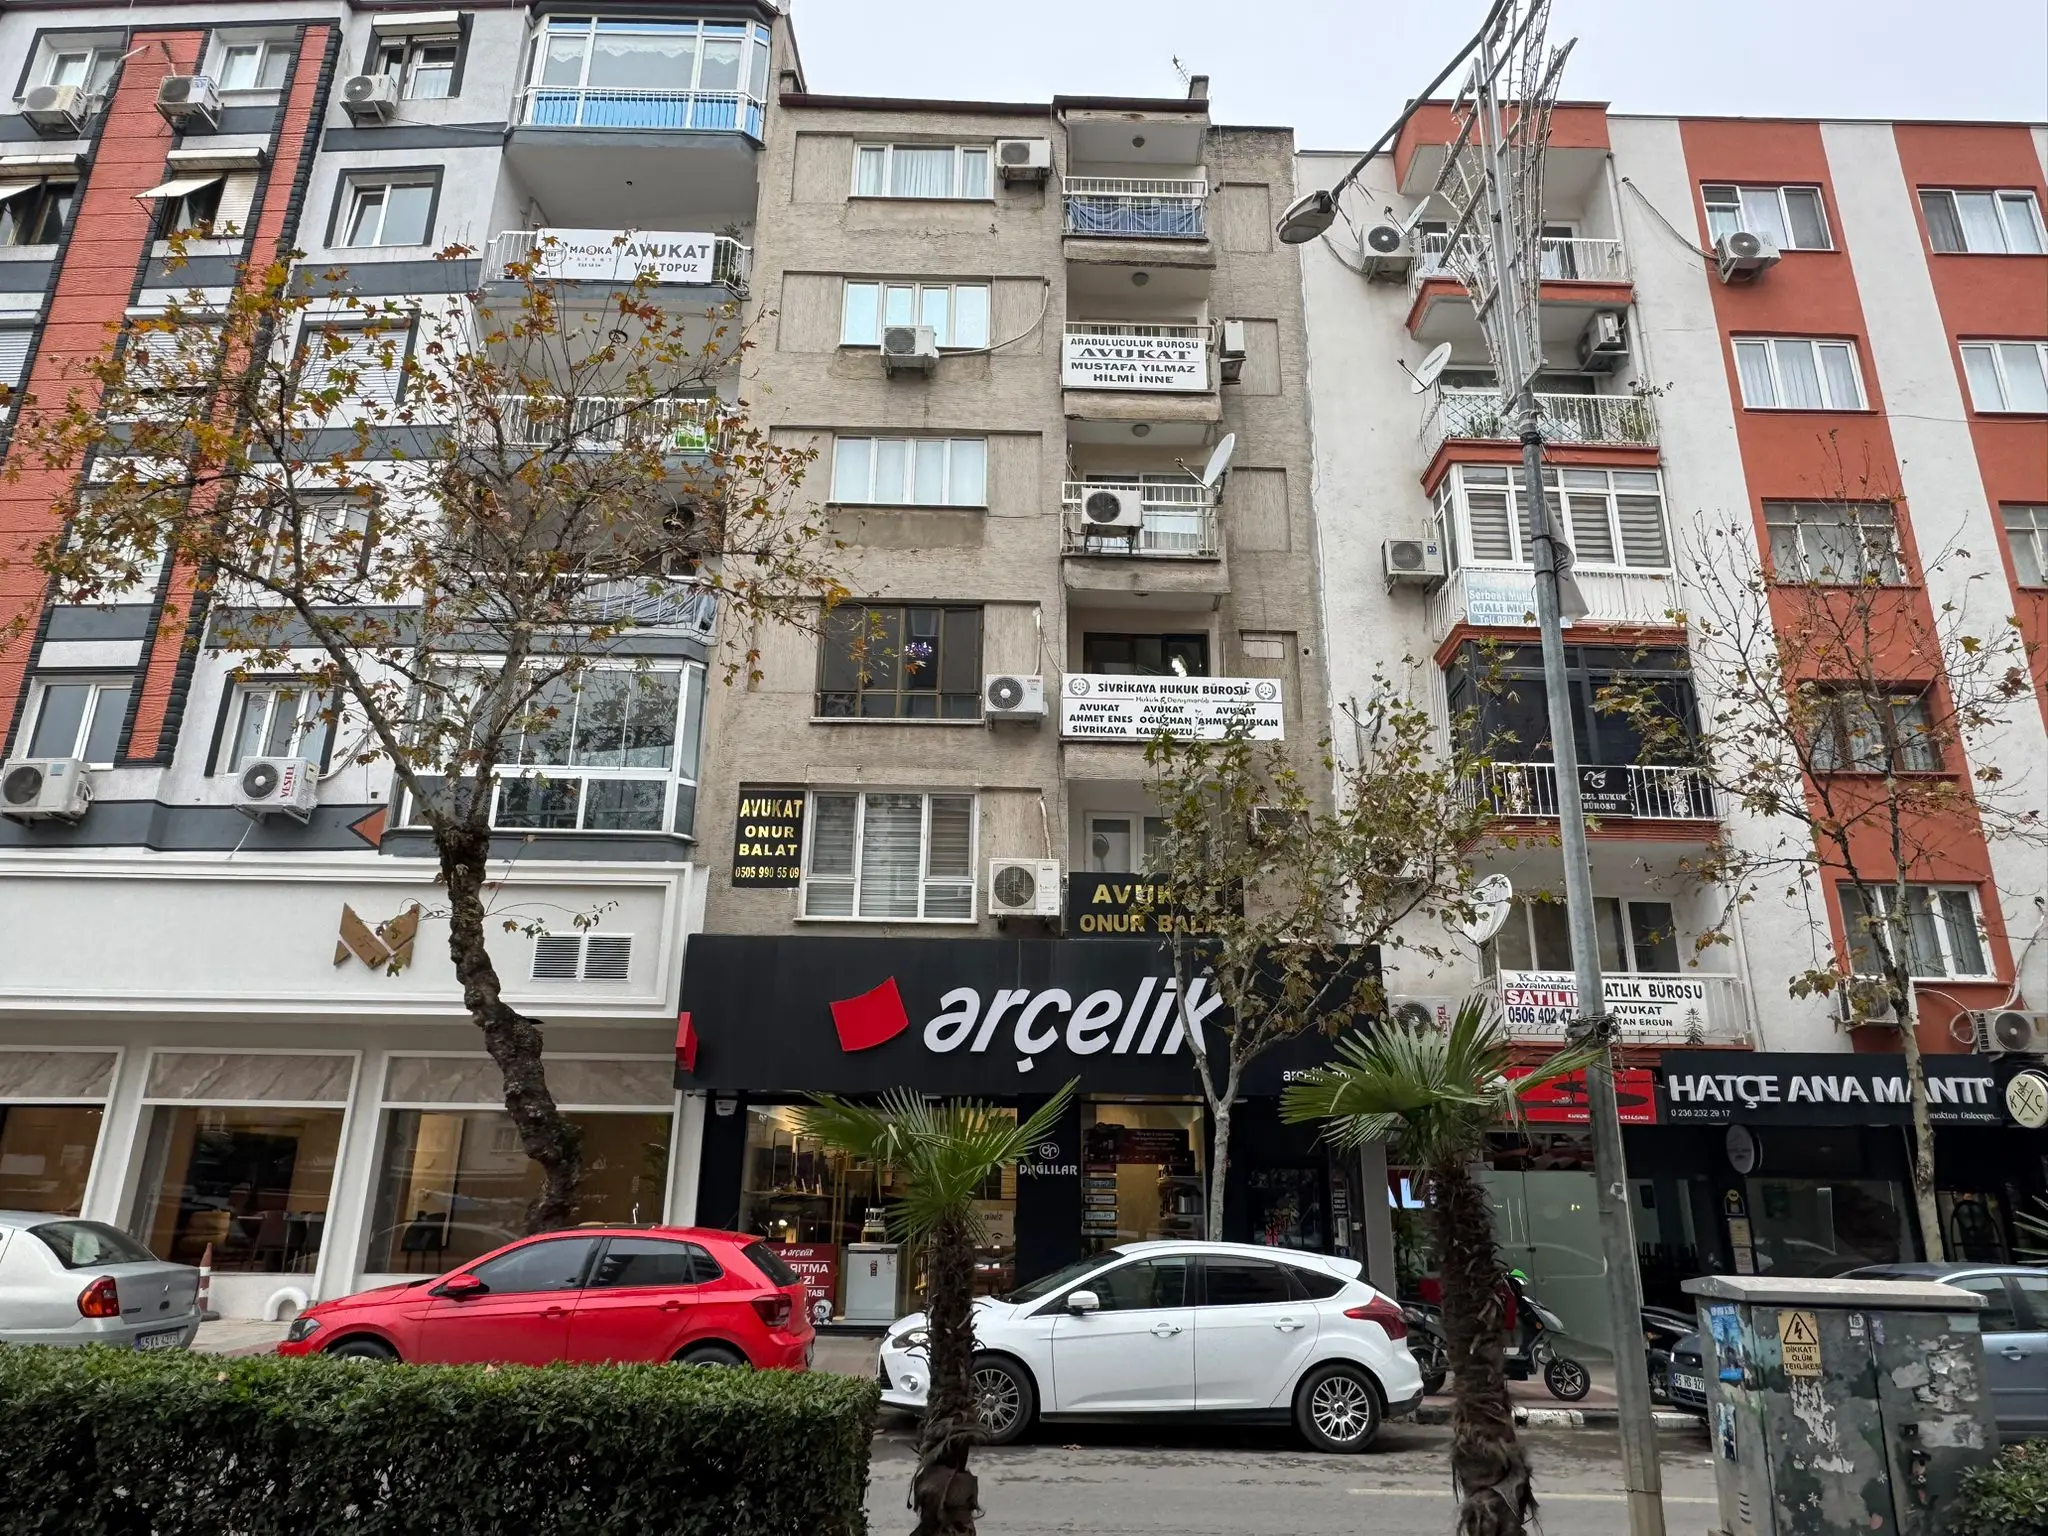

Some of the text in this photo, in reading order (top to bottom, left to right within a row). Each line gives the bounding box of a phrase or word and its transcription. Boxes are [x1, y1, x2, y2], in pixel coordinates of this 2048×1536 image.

[624, 243, 710, 259] AVUKAT
[659, 263, 698, 273] TOPUZ
[1070, 337, 1199, 349] ARABULUCULUK BÜROSU
[1079, 348, 1192, 360] AVUKAT
[1071, 362, 1196, 373] MUSTAFA YILMAZ
[1139, 374, 1174, 384] İNNE
[1097, 680, 1249, 696] SİVRİKAYA HUKUK BÜROSU
[1079, 703, 1120, 712] AVUKAT
[1143, 705, 1184, 714] AVUKAT
[1215, 707, 1256, 715] AVUKAT
[1069, 714, 1133, 723] AHMET ENES
[1139, 714, 1192, 726] OĞUZHAN
[1236, 718, 1278, 727] URKAN
[1072, 724, 1127, 734] SİVRİKAYA
[1598, 793, 1628, 801] HUKUK
[740, 799, 802, 818] AVUKAT
[1583, 800, 1616, 810] BÜROSU
[745, 825, 794, 838] ONUR
[739, 844, 798, 856] BALAT
[735, 866, 756, 878] 0505
[789, 867, 800, 878] 09
[1092, 884, 1221, 904] AVUKT
[1080, 914, 1146, 932] ONUR
[1506, 982, 1578, 990] GAYRİMENKU
[1604, 981, 1703, 999] ATLIK BÜROSU
[1508, 1006, 1572, 1024] 0506 402 47
[1613, 1005, 1662, 1015] AVUKAT
[922, 976, 1224, 1073] arçelik
[1618, 1018, 1636, 1026] TAN
[1668, 1074, 1781, 1109] HATÇE
[1787, 1075, 1869, 1102] ANA
[787, 1248, 814, 1258] arçelik
[790, 1263, 829, 1274] RITMA
